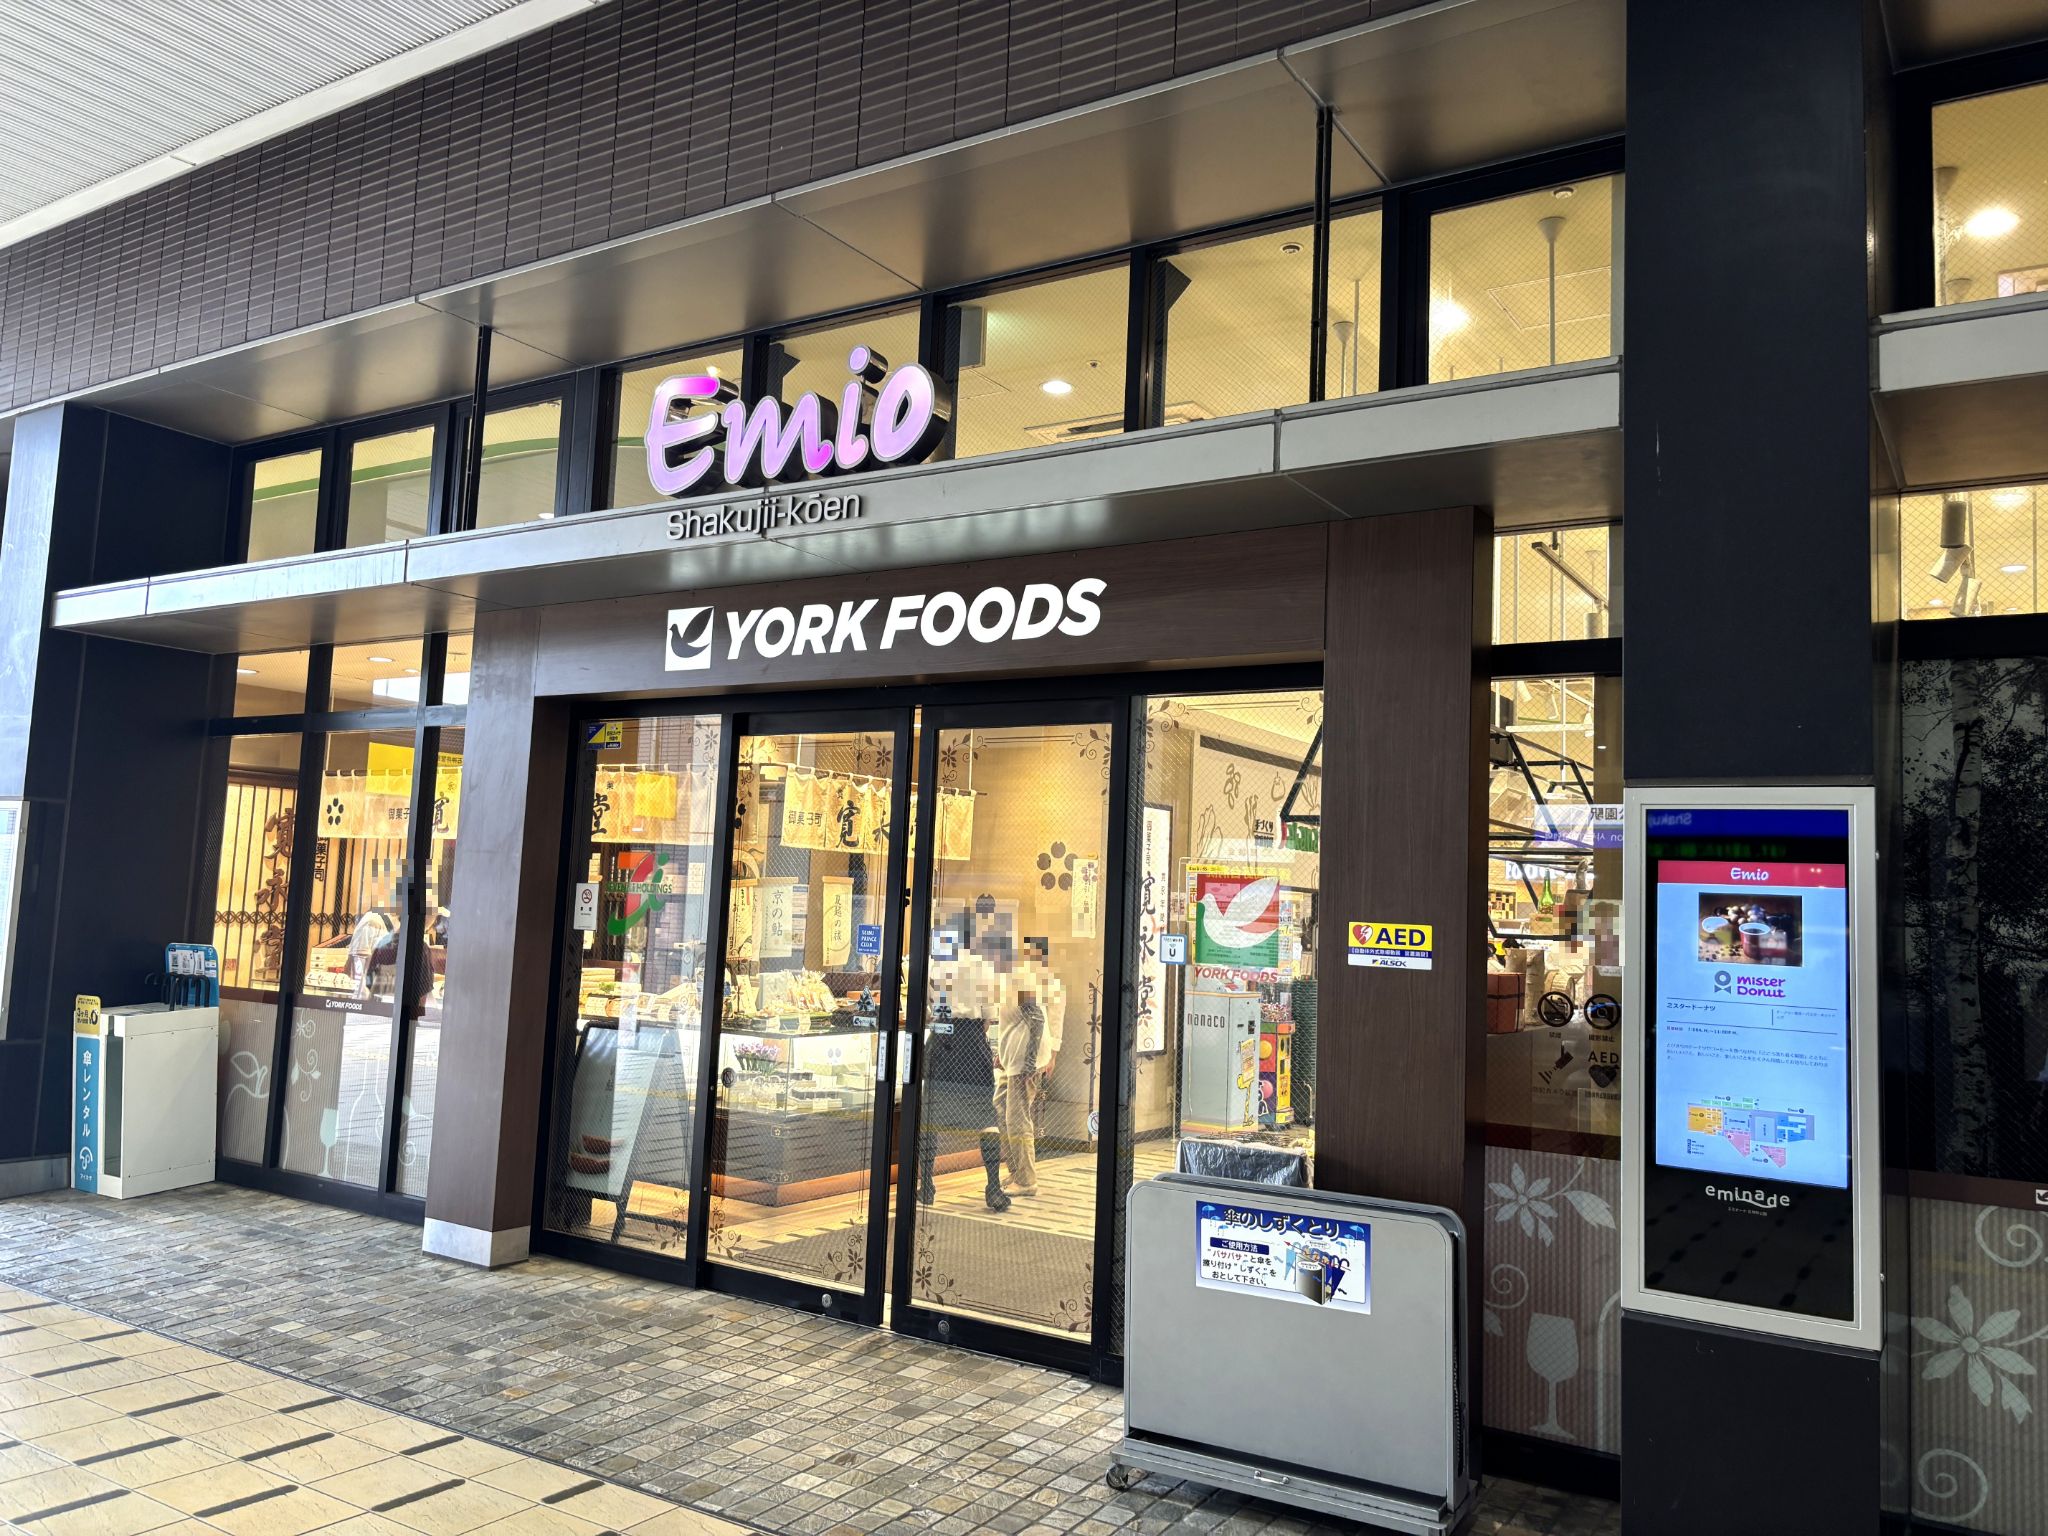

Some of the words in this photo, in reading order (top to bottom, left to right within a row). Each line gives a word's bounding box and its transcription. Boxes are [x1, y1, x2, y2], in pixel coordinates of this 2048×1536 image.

[644, 343, 937, 497] Emio
[724, 598, 880, 661] YORK
[879, 576, 1108, 650] FOODS
[1730, 867, 1769, 881] Emio
[1375, 927, 1426, 947] AED
[1194, 966, 1232, 979] YORK
[1231, 969, 1280, 984] FOODS
[1737, 974, 1786, 987] mister
[1736, 985, 1786, 998] Donut
[331, 1000, 345, 1009] YORK
[345, 1002, 363, 1011] FOODS
[1187, 1011, 1226, 1029] nanaco
[1588, 1050, 1619, 1064] AED
[82, 1049, 93, 1138] 傘レンタル
[1704, 1185, 1791, 1209] eminade
[1223, 1208, 1340, 1241] 傘のしずくとり
[1221, 1240, 1258, 1253] ご使用方法
